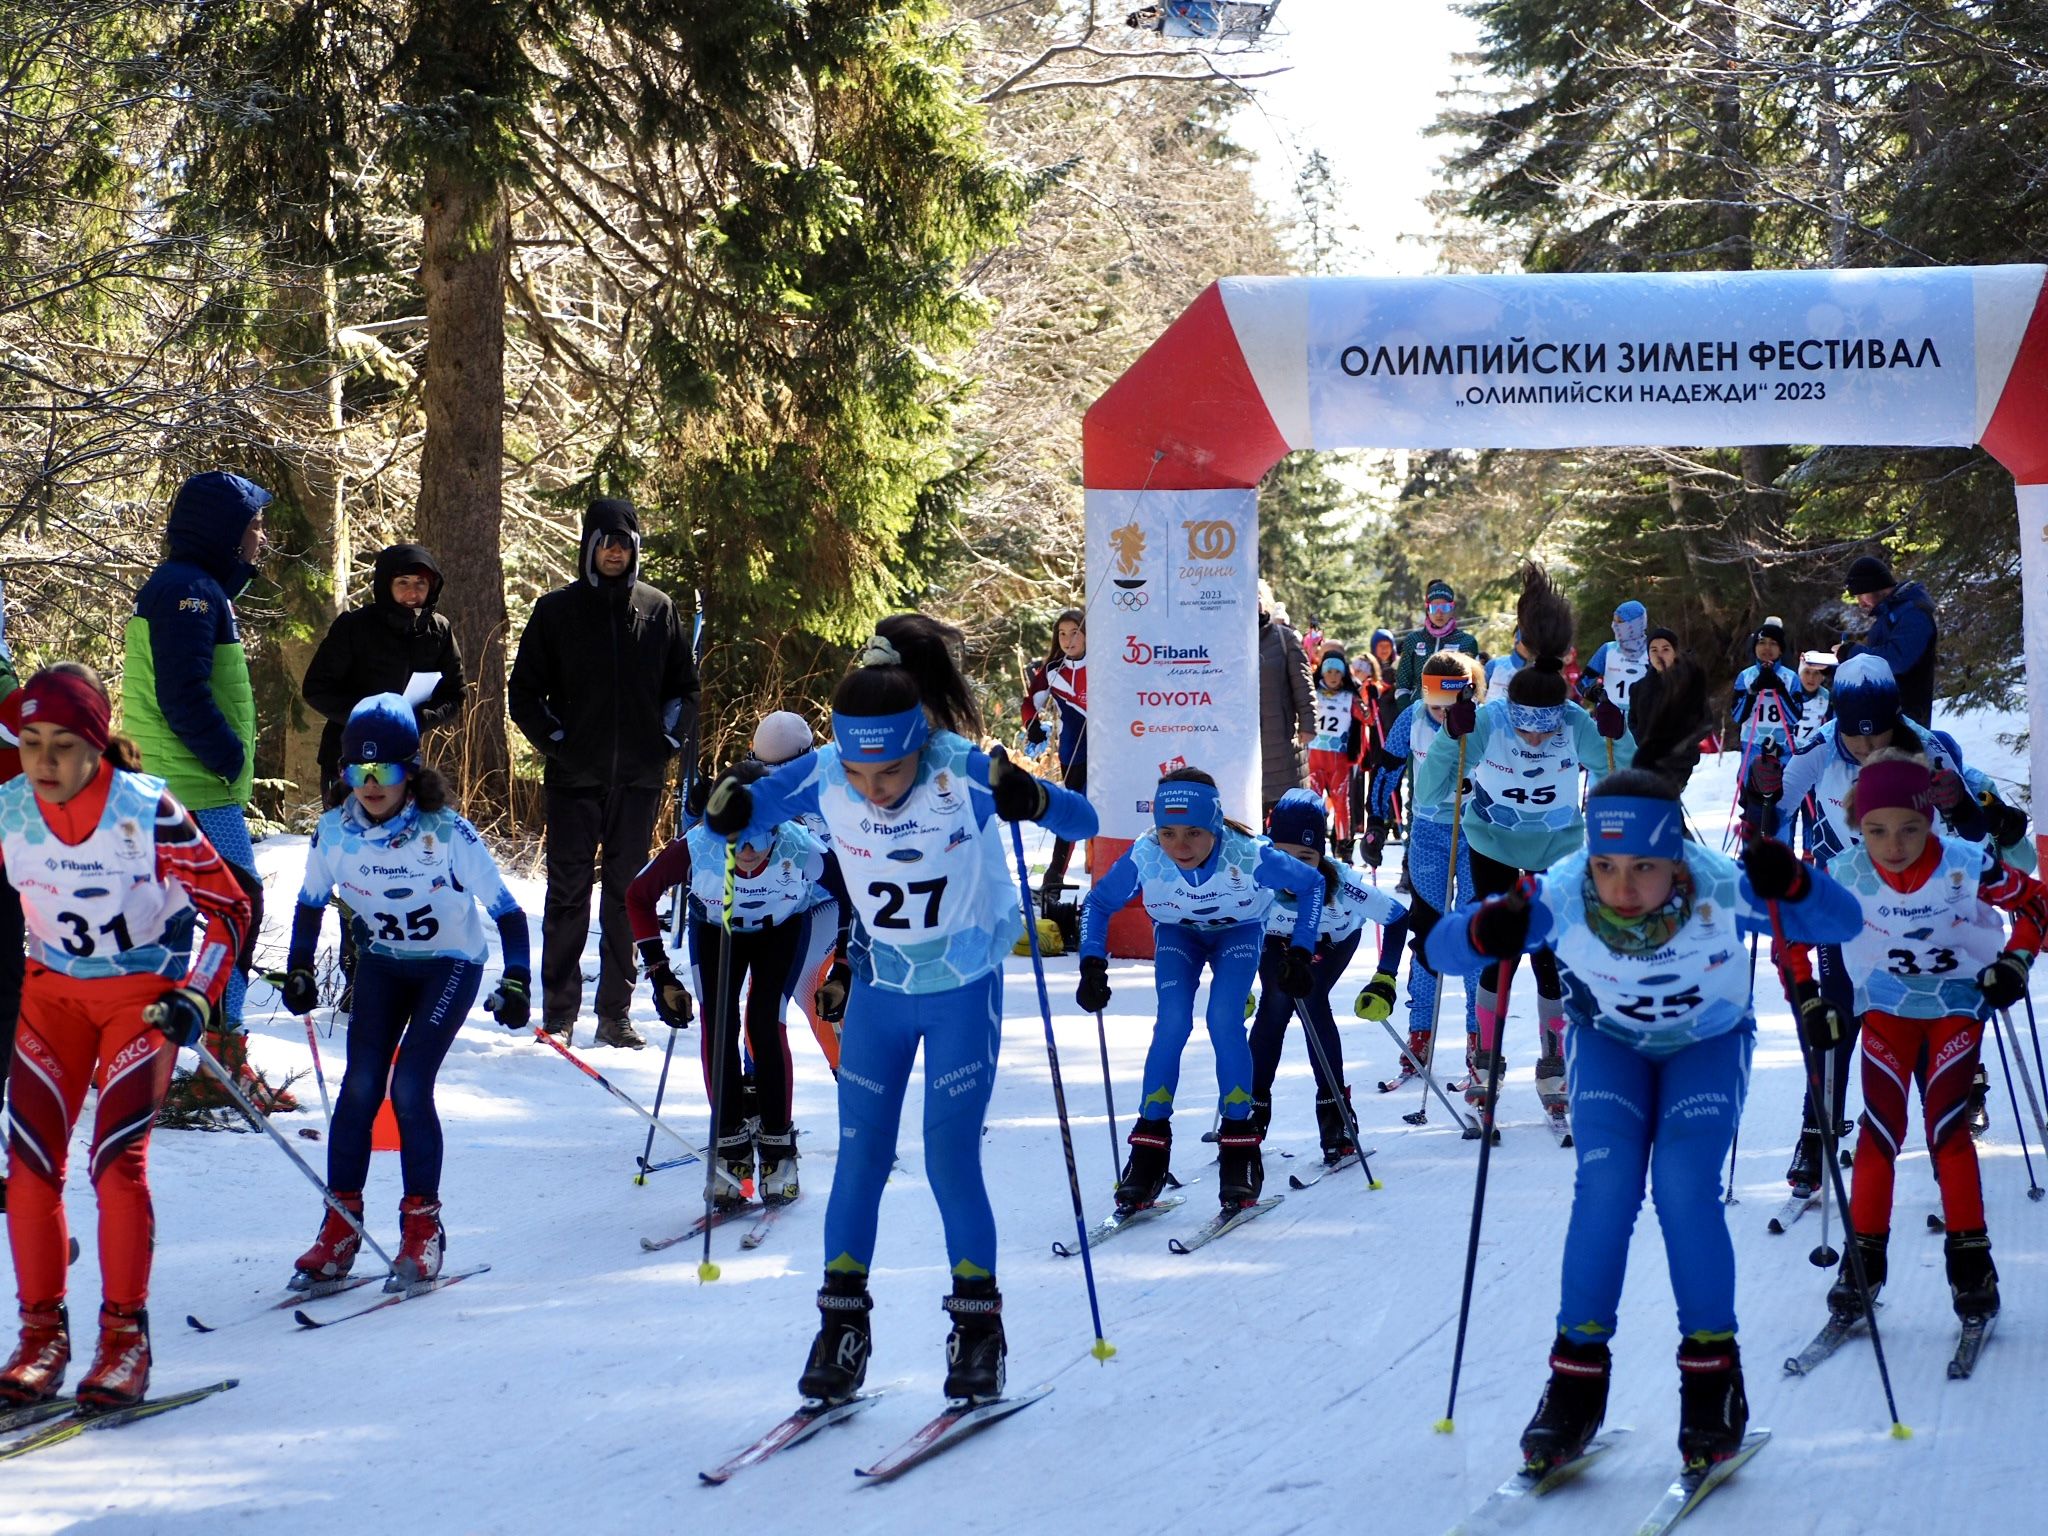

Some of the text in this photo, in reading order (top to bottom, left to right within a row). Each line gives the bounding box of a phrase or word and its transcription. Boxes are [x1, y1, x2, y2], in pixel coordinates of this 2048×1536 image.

[1341, 336, 1941, 376] ОЛИМПИЙСКИ ЗИМЕН ФЕСТИВАЛ
[1774, 382, 1826, 401] 2023
[1200, 590, 1222, 600] 2023
[1153, 645, 1210, 659] Fibank
[1137, 692, 1212, 706] TOYOTA
[1755, 704, 1781, 722] 18
[1149, 725, 1219, 733] ЕЛЕКТРОХОЛД
[1318, 715, 1339, 732] 12
[1794, 724, 1814, 738] 17
[1502, 785, 1556, 805] 45
[874, 820, 919, 836] Fibank
[61, 860, 104, 871] Fibank
[373, 865, 409, 875] Fibank
[735, 886, 768, 895] Fibank
[867, 875, 948, 929] 27
[1893, 905, 1933, 917] Fibank
[374, 904, 440, 941] 35
[57, 911, 134, 958] 31
[1888, 948, 1959, 975] 33
[1615, 984, 1704, 1023] 25
[1936, 1031, 1970, 1067] АЯКС
[107, 1037, 150, 1080] АЯКС
[933, 1061, 983, 1090] САПАРЕВА
[948, 1078, 977, 1097] БАНЯ
[1664, 1093, 1729, 1119] САПАРЕВА
[1684, 1106, 1720, 1119] БАНЯ
[817, 1296, 867, 1309] OSSIGNOL
